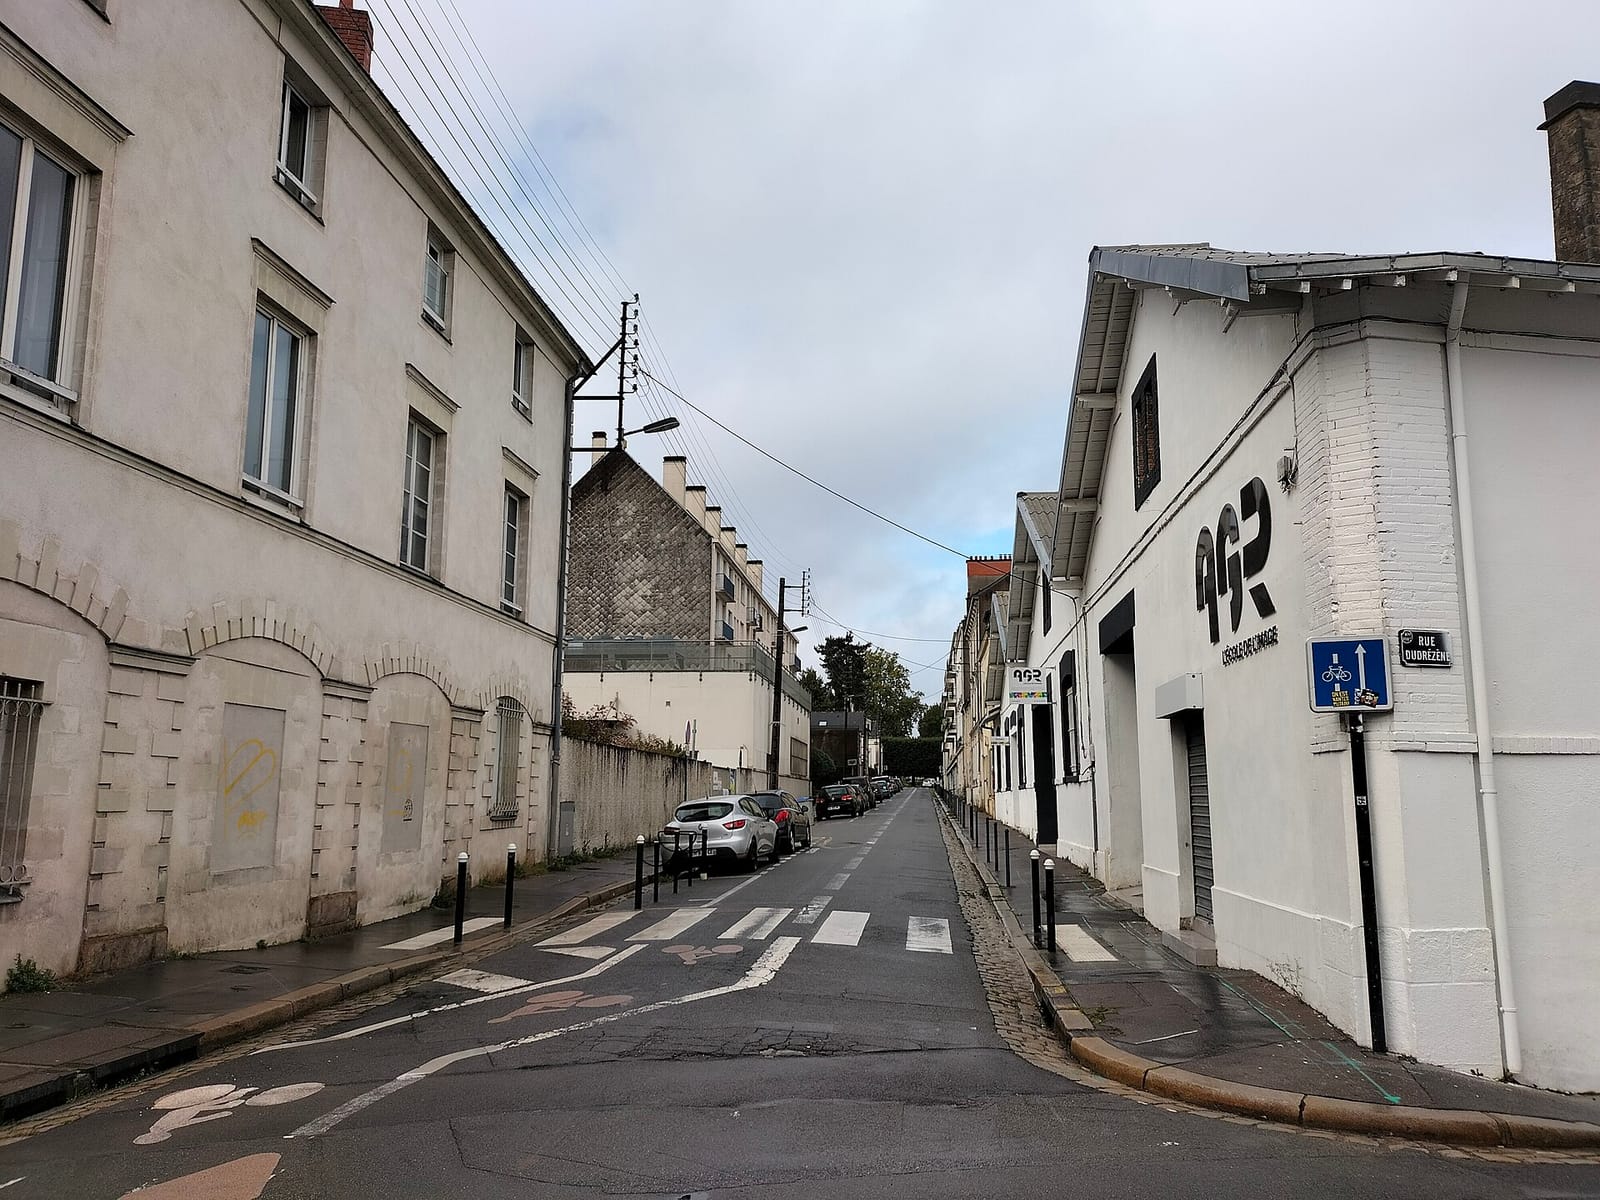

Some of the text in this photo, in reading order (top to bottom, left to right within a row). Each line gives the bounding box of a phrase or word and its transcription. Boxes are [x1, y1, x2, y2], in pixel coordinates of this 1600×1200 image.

[1196, 476, 1277, 645] AGR
[1418, 635, 1436, 647] RUE
[1013, 669, 1042, 682] AGR
